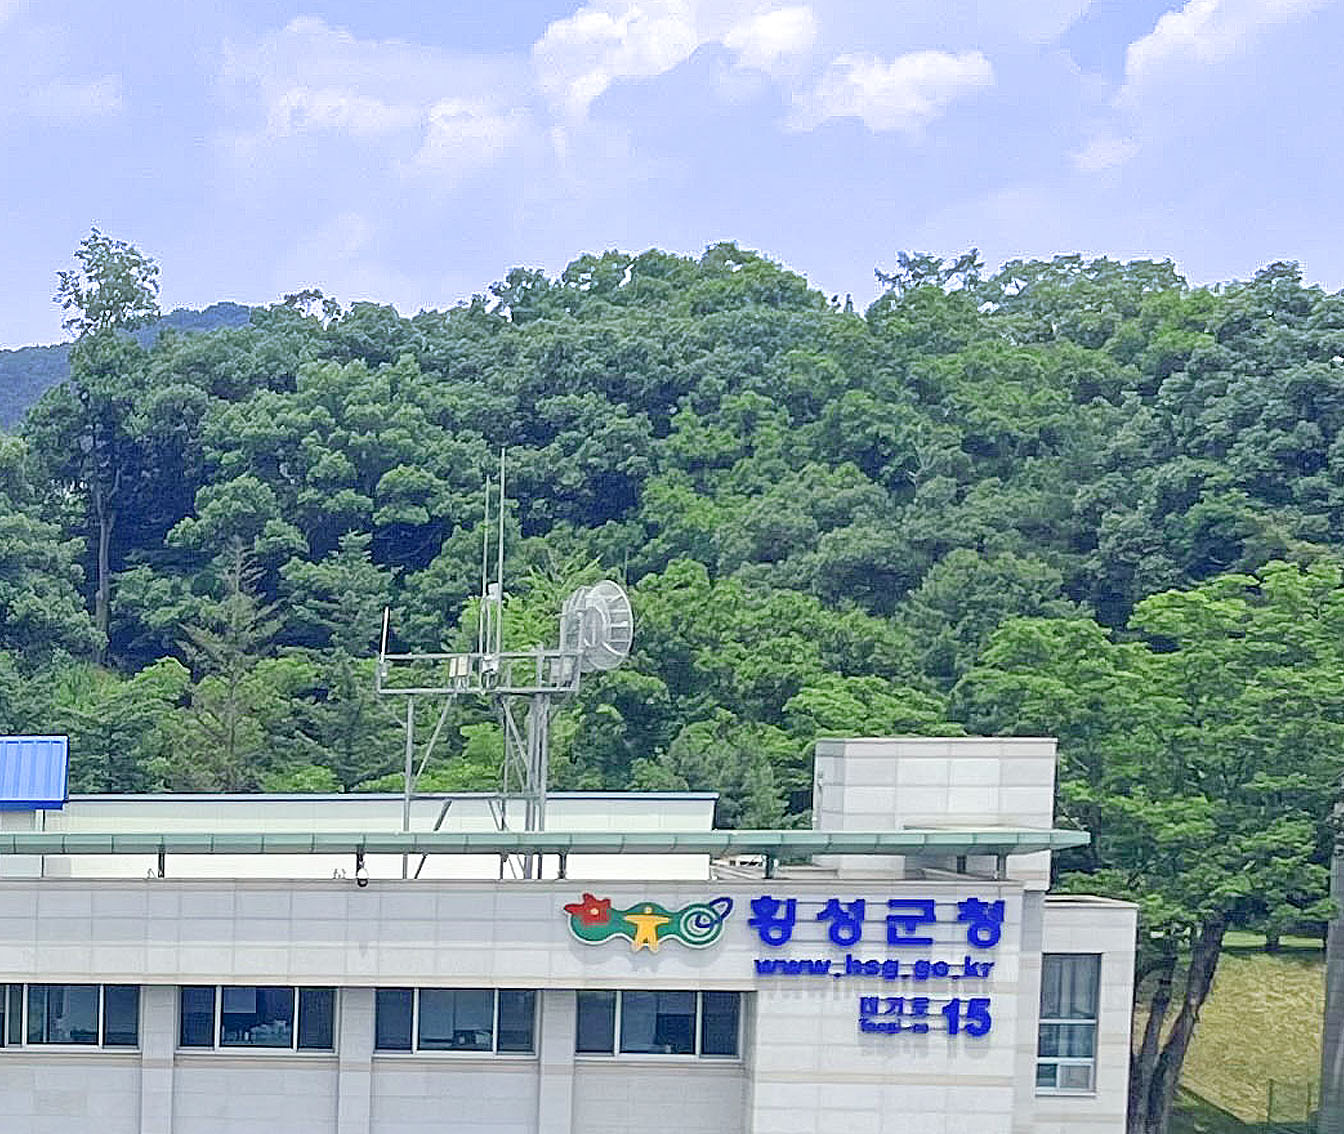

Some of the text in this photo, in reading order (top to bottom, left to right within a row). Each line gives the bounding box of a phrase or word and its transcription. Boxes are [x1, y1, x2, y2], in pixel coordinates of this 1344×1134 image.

[748, 895, 1005, 948] 횡성군청
[753, 954, 995, 980] www.hsg.go.kr
[942, 998, 991, 1037] 15
